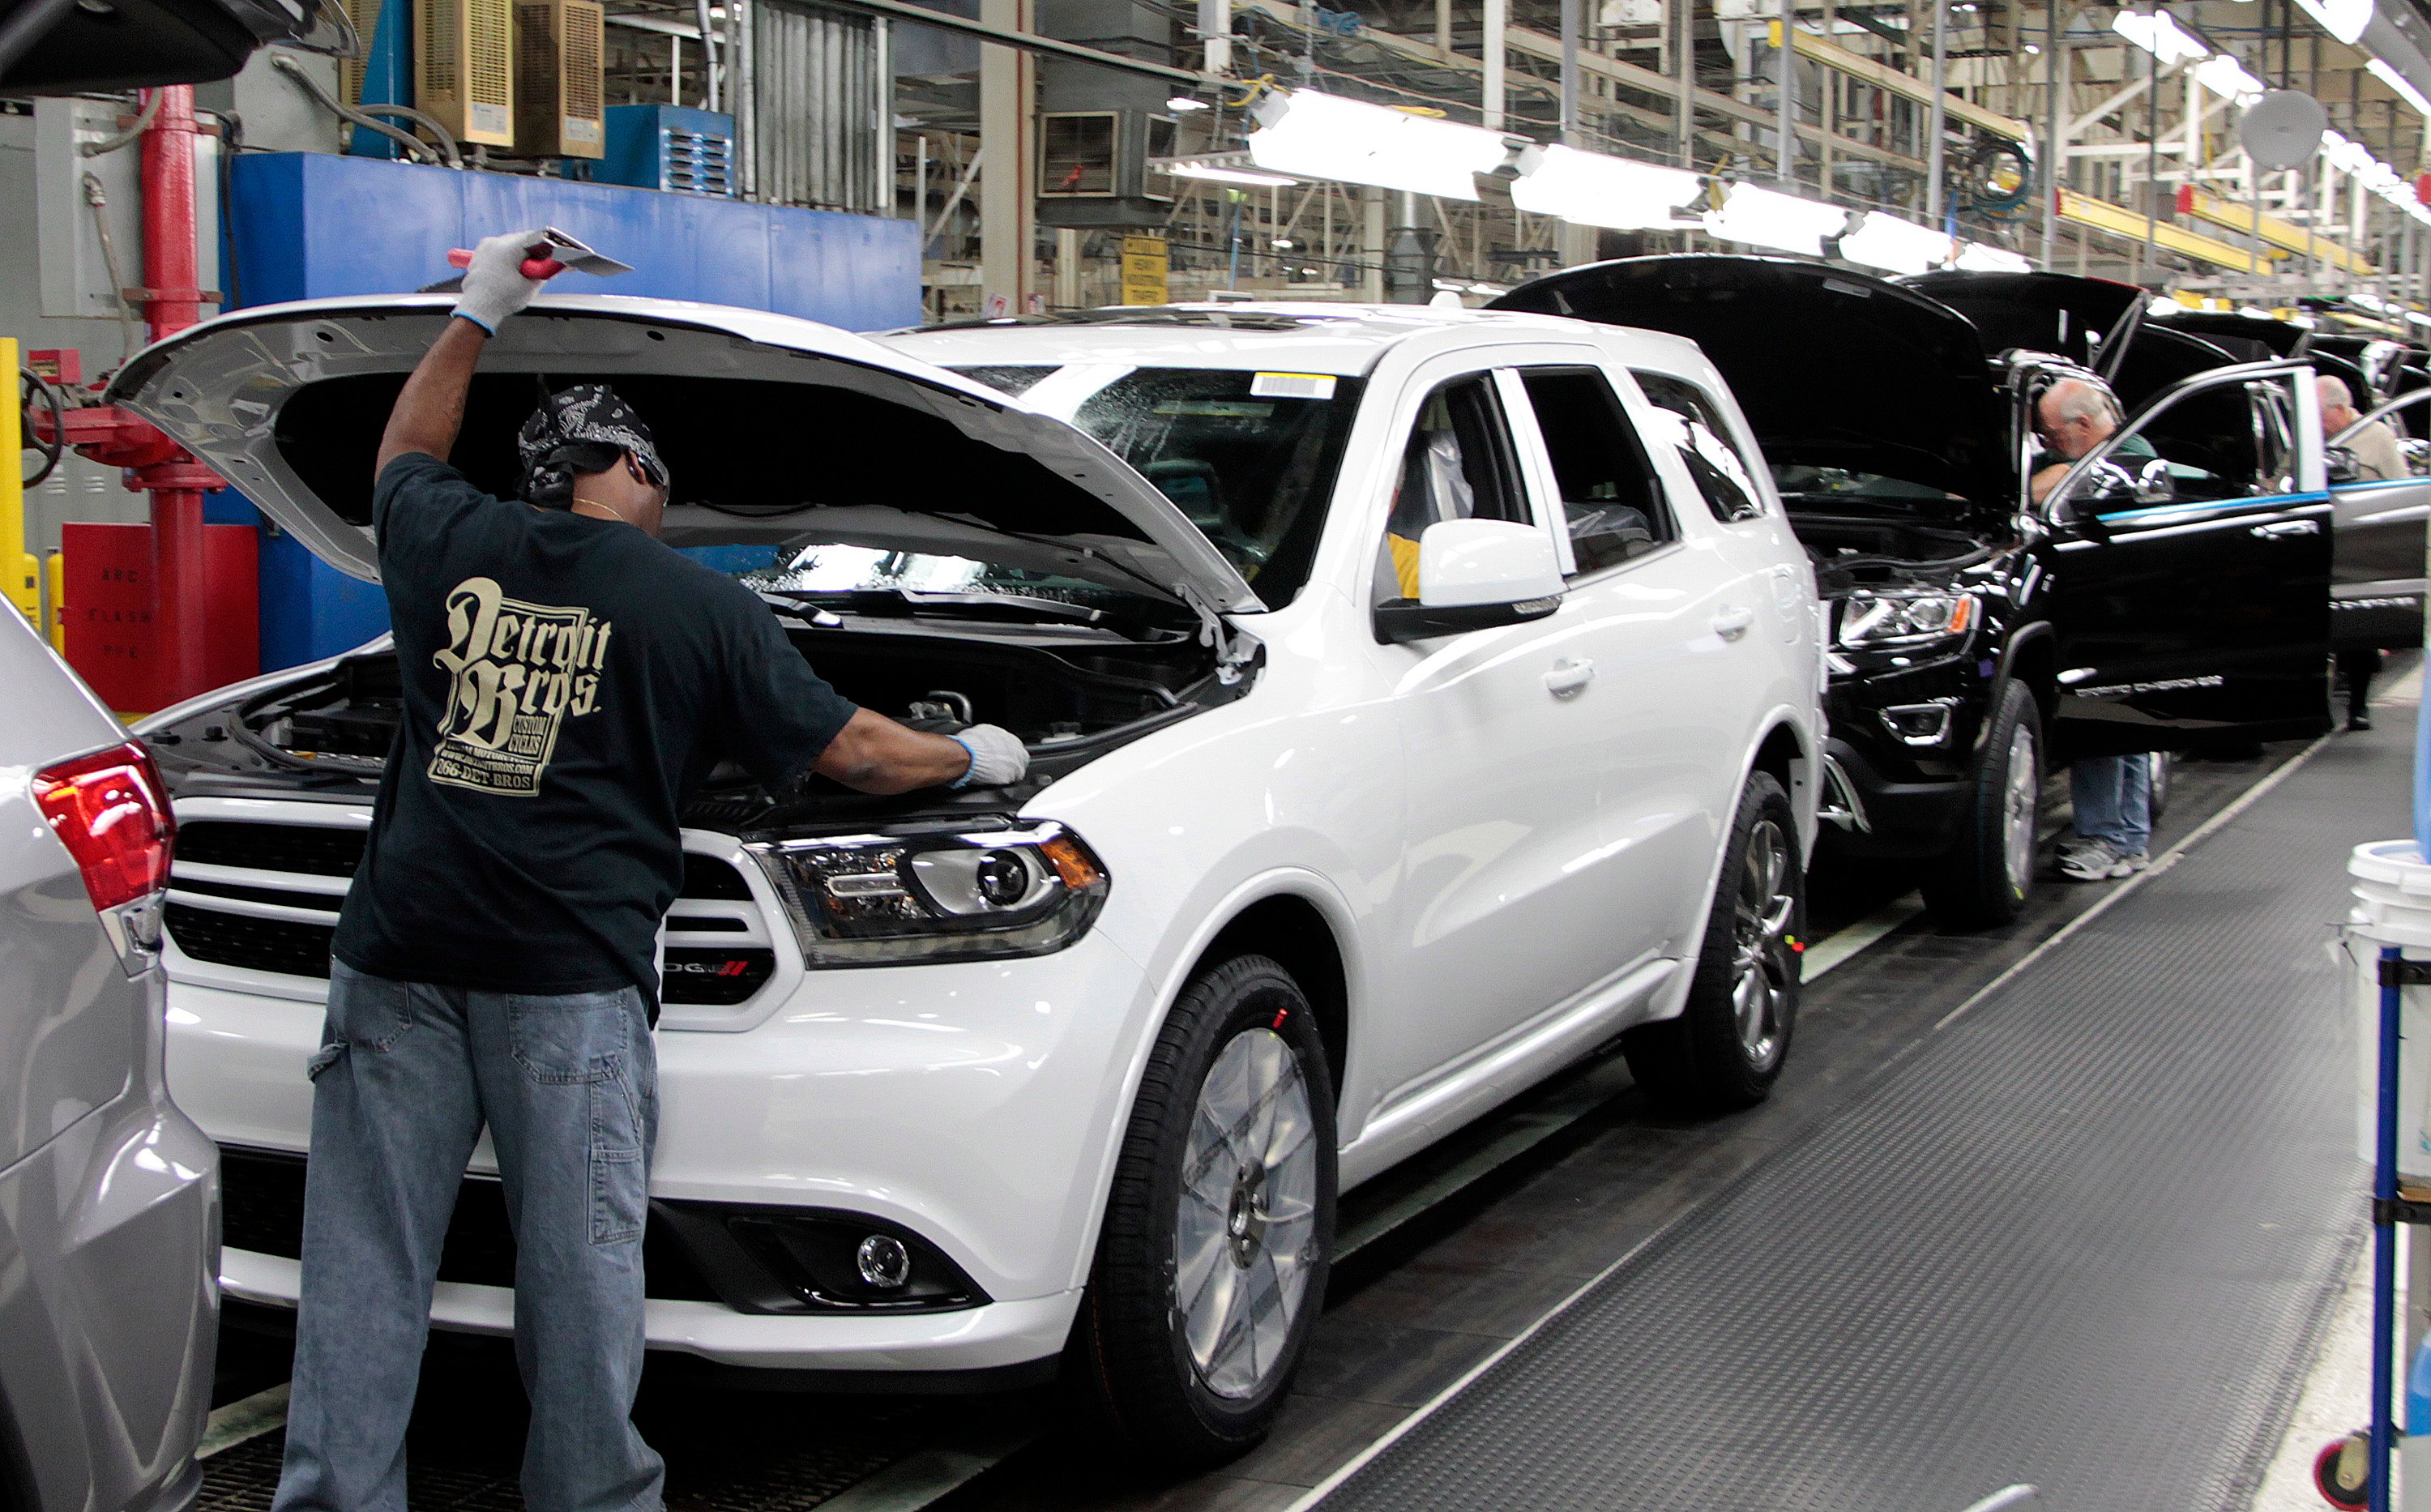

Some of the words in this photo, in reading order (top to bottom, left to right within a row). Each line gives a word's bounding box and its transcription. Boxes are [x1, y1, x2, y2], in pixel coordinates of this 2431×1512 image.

[433, 577, 612, 674] Detroit
[451, 659, 602, 750] Bros.
[512, 714, 548, 736] CUSTOM
